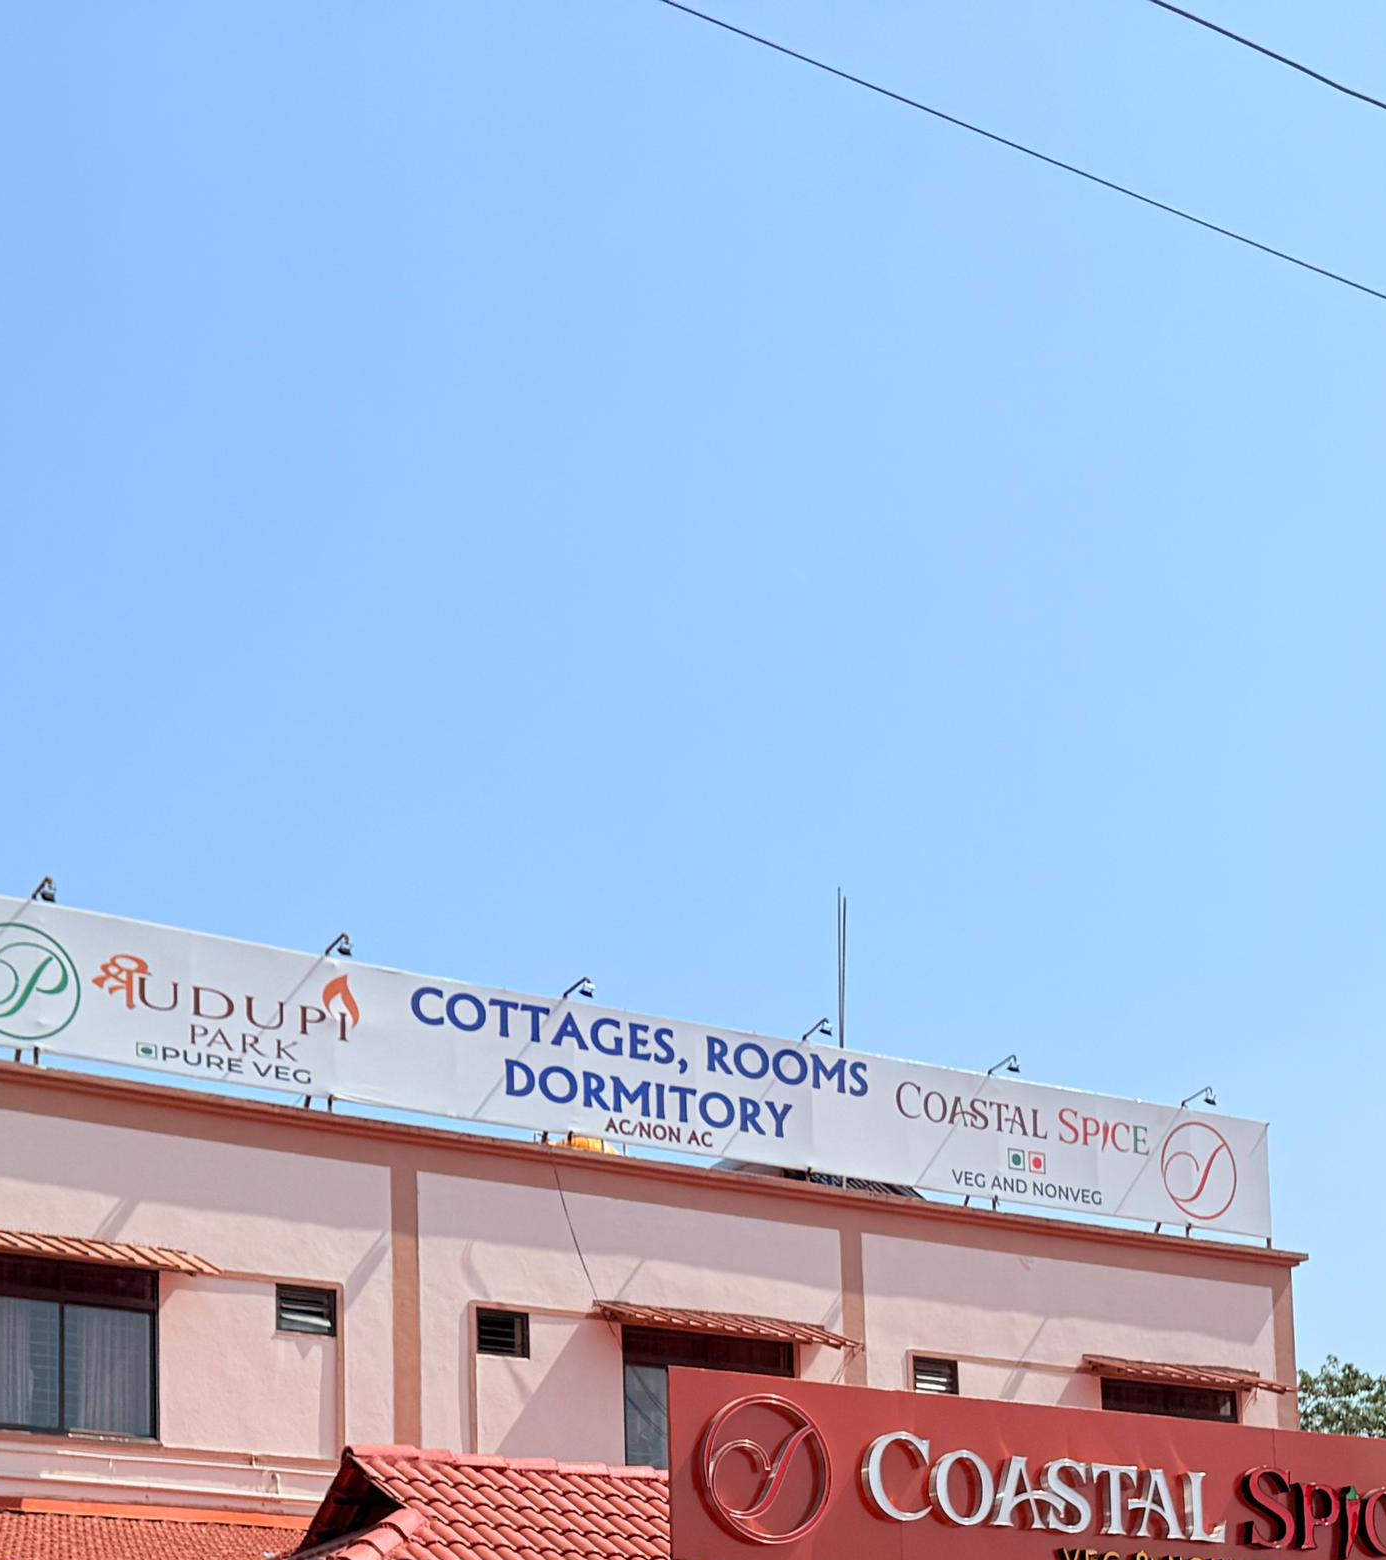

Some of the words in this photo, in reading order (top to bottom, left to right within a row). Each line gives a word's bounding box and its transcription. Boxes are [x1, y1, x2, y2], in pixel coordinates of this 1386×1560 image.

[162, 1046, 244, 1074] PURE
[253, 1061, 312, 1085] VEG
[190, 1024, 299, 1062] PARK
[410, 986, 688, 1074] COTTAGES,
[705, 1035, 869, 1098] ROOMS
[504, 1059, 793, 1138] DORMITORY
[895, 1081, 1049, 1140] COASTAL
[605, 1119, 681, 1144] AC/NON
[688, 1130, 713, 1148] AC
[951, 1169, 986, 1189] VEG
[990, 1175, 1027, 1194] AND
[1033, 1182, 1102, 1206] NONVEG
[862, 1430, 1226, 1545] COASTAL
